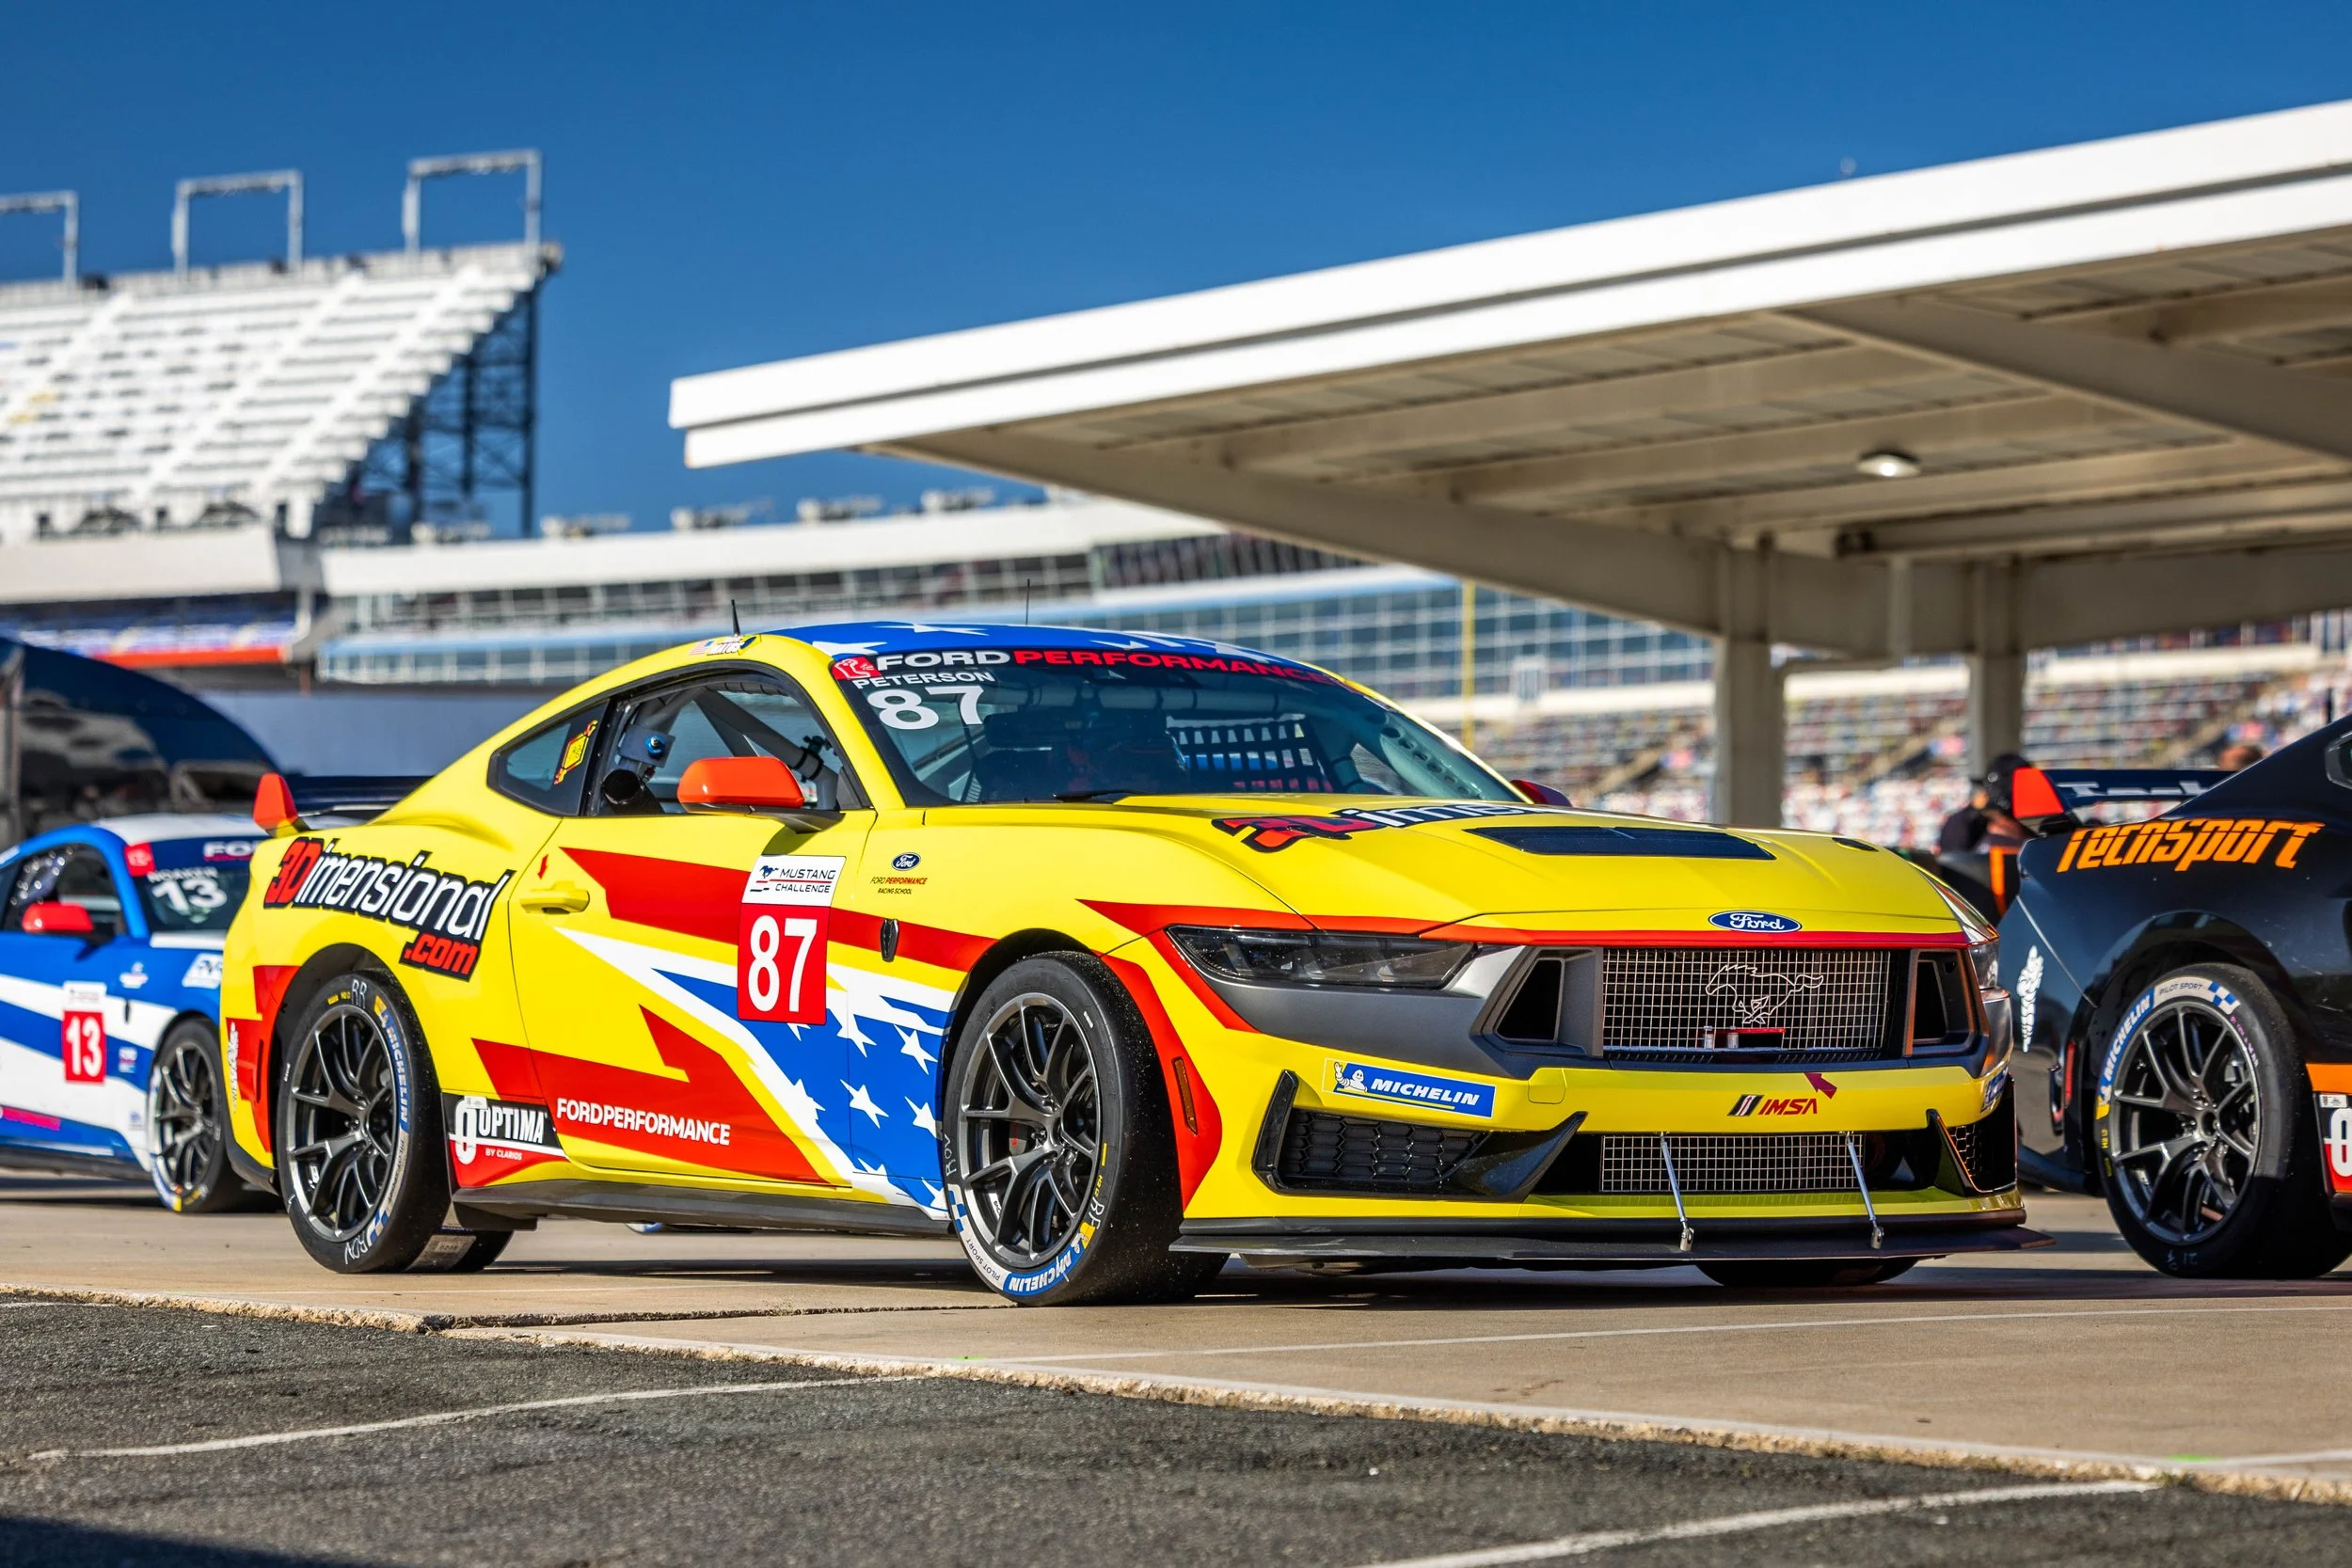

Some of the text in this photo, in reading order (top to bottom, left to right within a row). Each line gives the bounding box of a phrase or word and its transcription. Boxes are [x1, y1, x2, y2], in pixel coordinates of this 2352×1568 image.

[852, 671, 995, 689] PETERSON
[877, 650, 1010, 672] FORD
[866, 686, 984, 730] 87
[780, 869, 836, 879] MUSTANG
[895, 854, 917, 868] Ford
[151, 878, 227, 916] 13
[265, 839, 510, 941] 3Dimensional
[774, 883, 831, 893] CHALLENGE
[1724, 912, 1788, 932] Ford
[404, 932, 478, 974] .com
[748, 914, 818, 1013] 87
[66, 1016, 103, 1077] 13
[2104, 994, 2151, 1082] MICHELIN
[386, 1026, 407, 1122] MICHELIN
[1370, 1078, 1480, 1106] MICHELIN
[478, 1105, 545, 1144] OPTIMA
[1758, 1098, 1818, 1116] IMSA
[485, 1148, 523, 1161] BY CLARIOS
[966, 1238, 1072, 1292] MICHELIN PILOT SPORT
